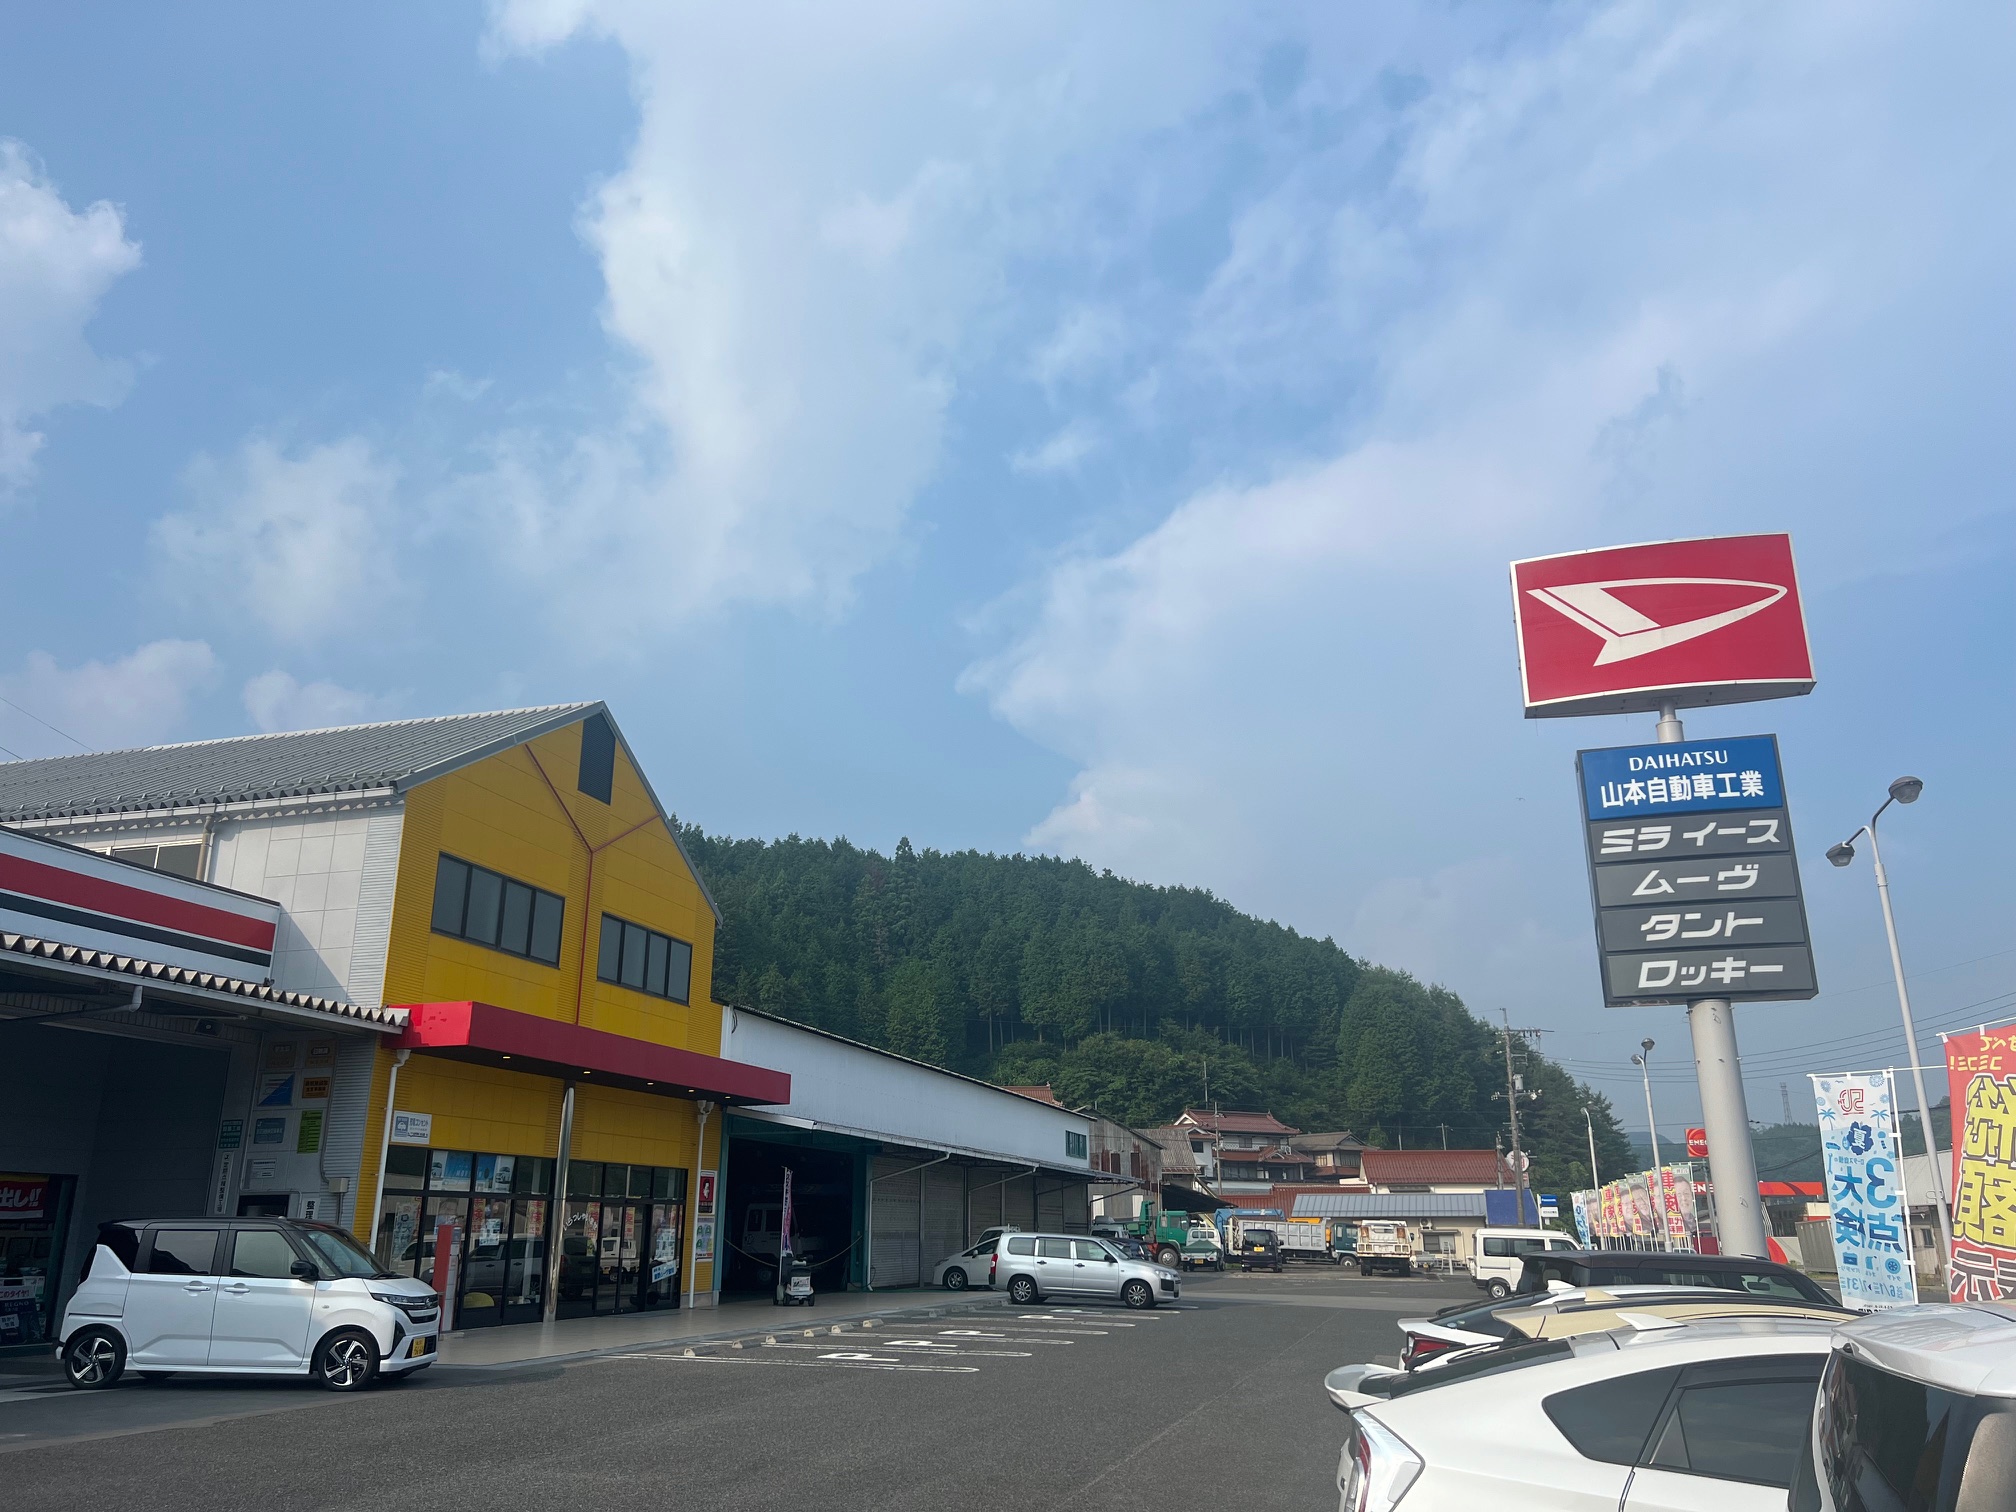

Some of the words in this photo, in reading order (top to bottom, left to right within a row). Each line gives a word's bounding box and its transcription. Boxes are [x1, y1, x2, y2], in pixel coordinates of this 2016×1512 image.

[1629, 750, 1728, 771] DAIHATSU
[1601, 770, 1764, 808] 山本自動車工業
[1601, 826, 1672, 854] ミラ
[1683, 819, 1780, 847] イース
[1632, 864, 1759, 896] ムーヴ
[1641, 912, 1763, 941] タント
[1638, 957, 1784, 988] ロッキー
